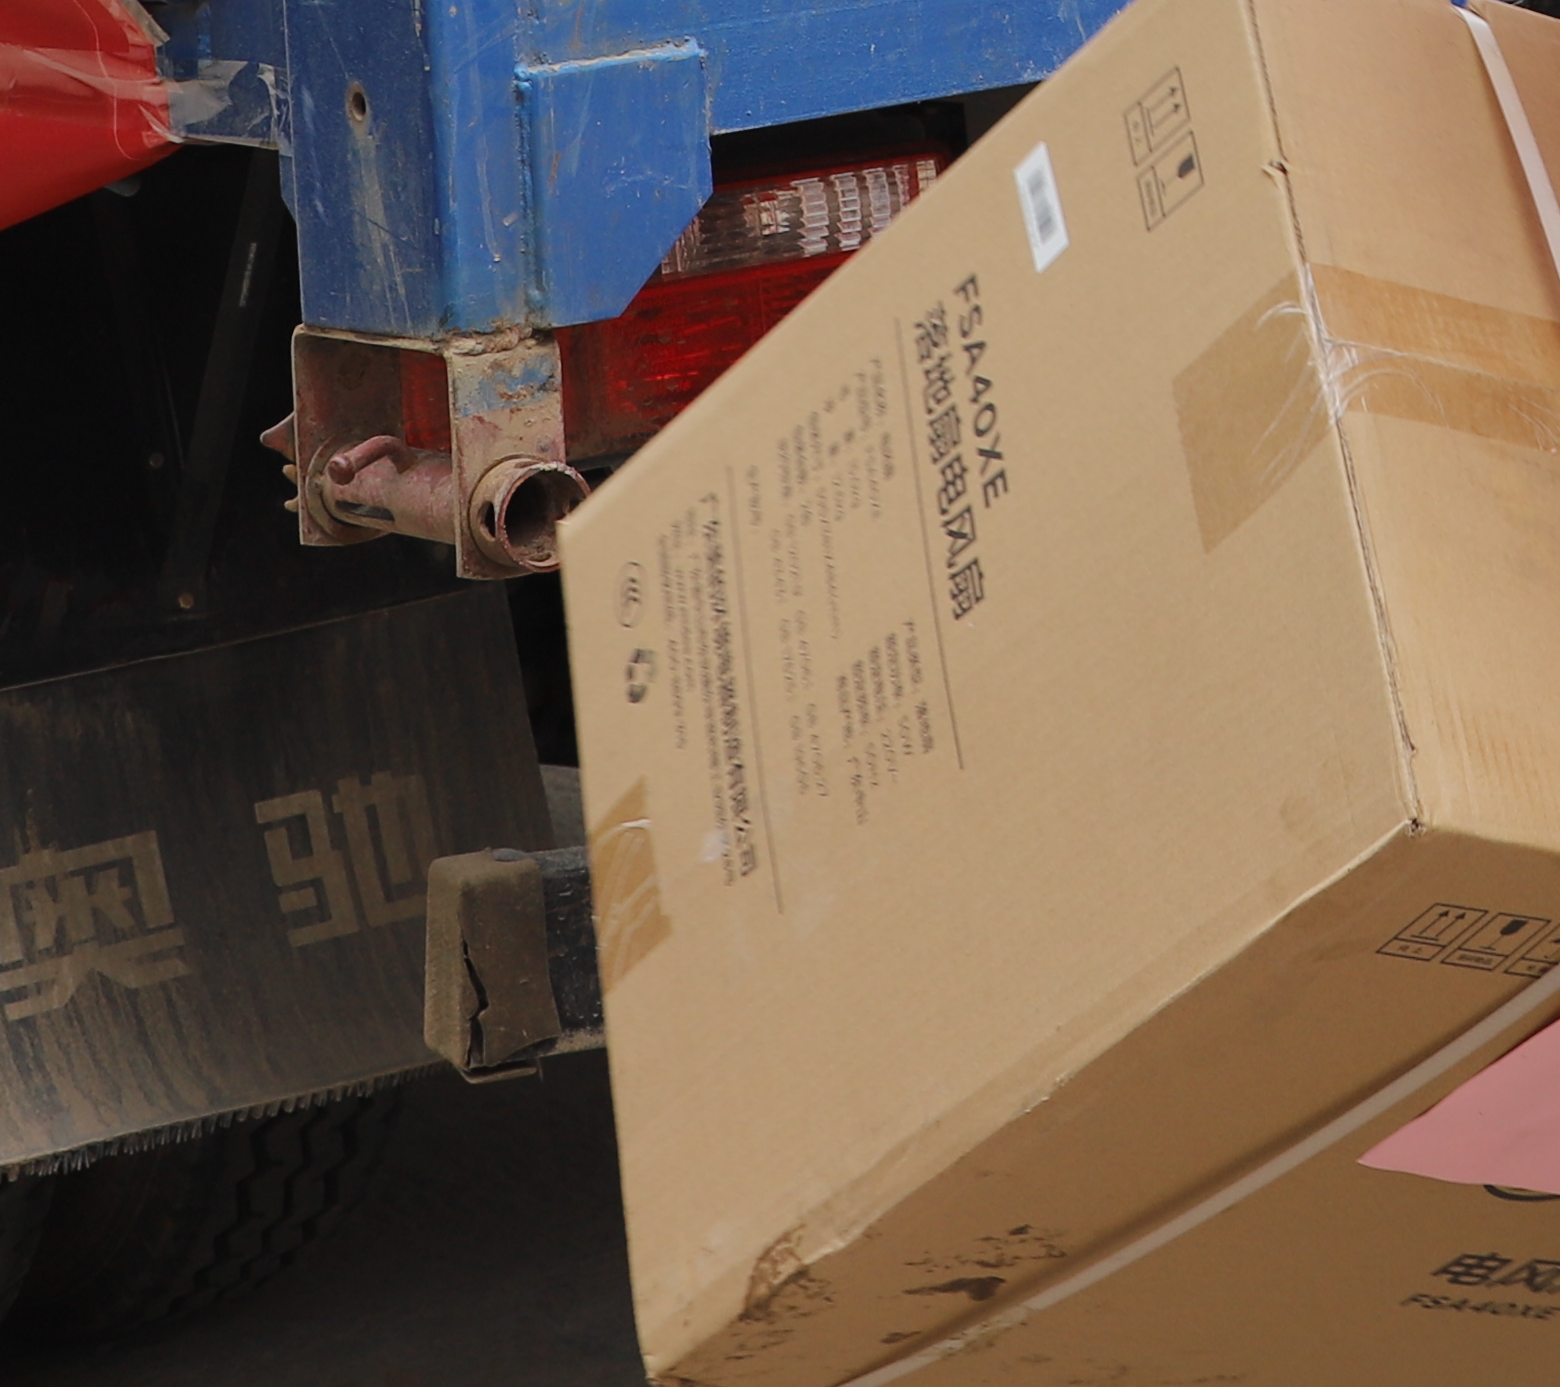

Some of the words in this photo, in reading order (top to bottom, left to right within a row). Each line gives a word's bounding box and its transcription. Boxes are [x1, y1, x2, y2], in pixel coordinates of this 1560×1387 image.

[913, 300, 986, 621] 落地扇电风扇
[953, 273, 1009, 510] FSA40XE
